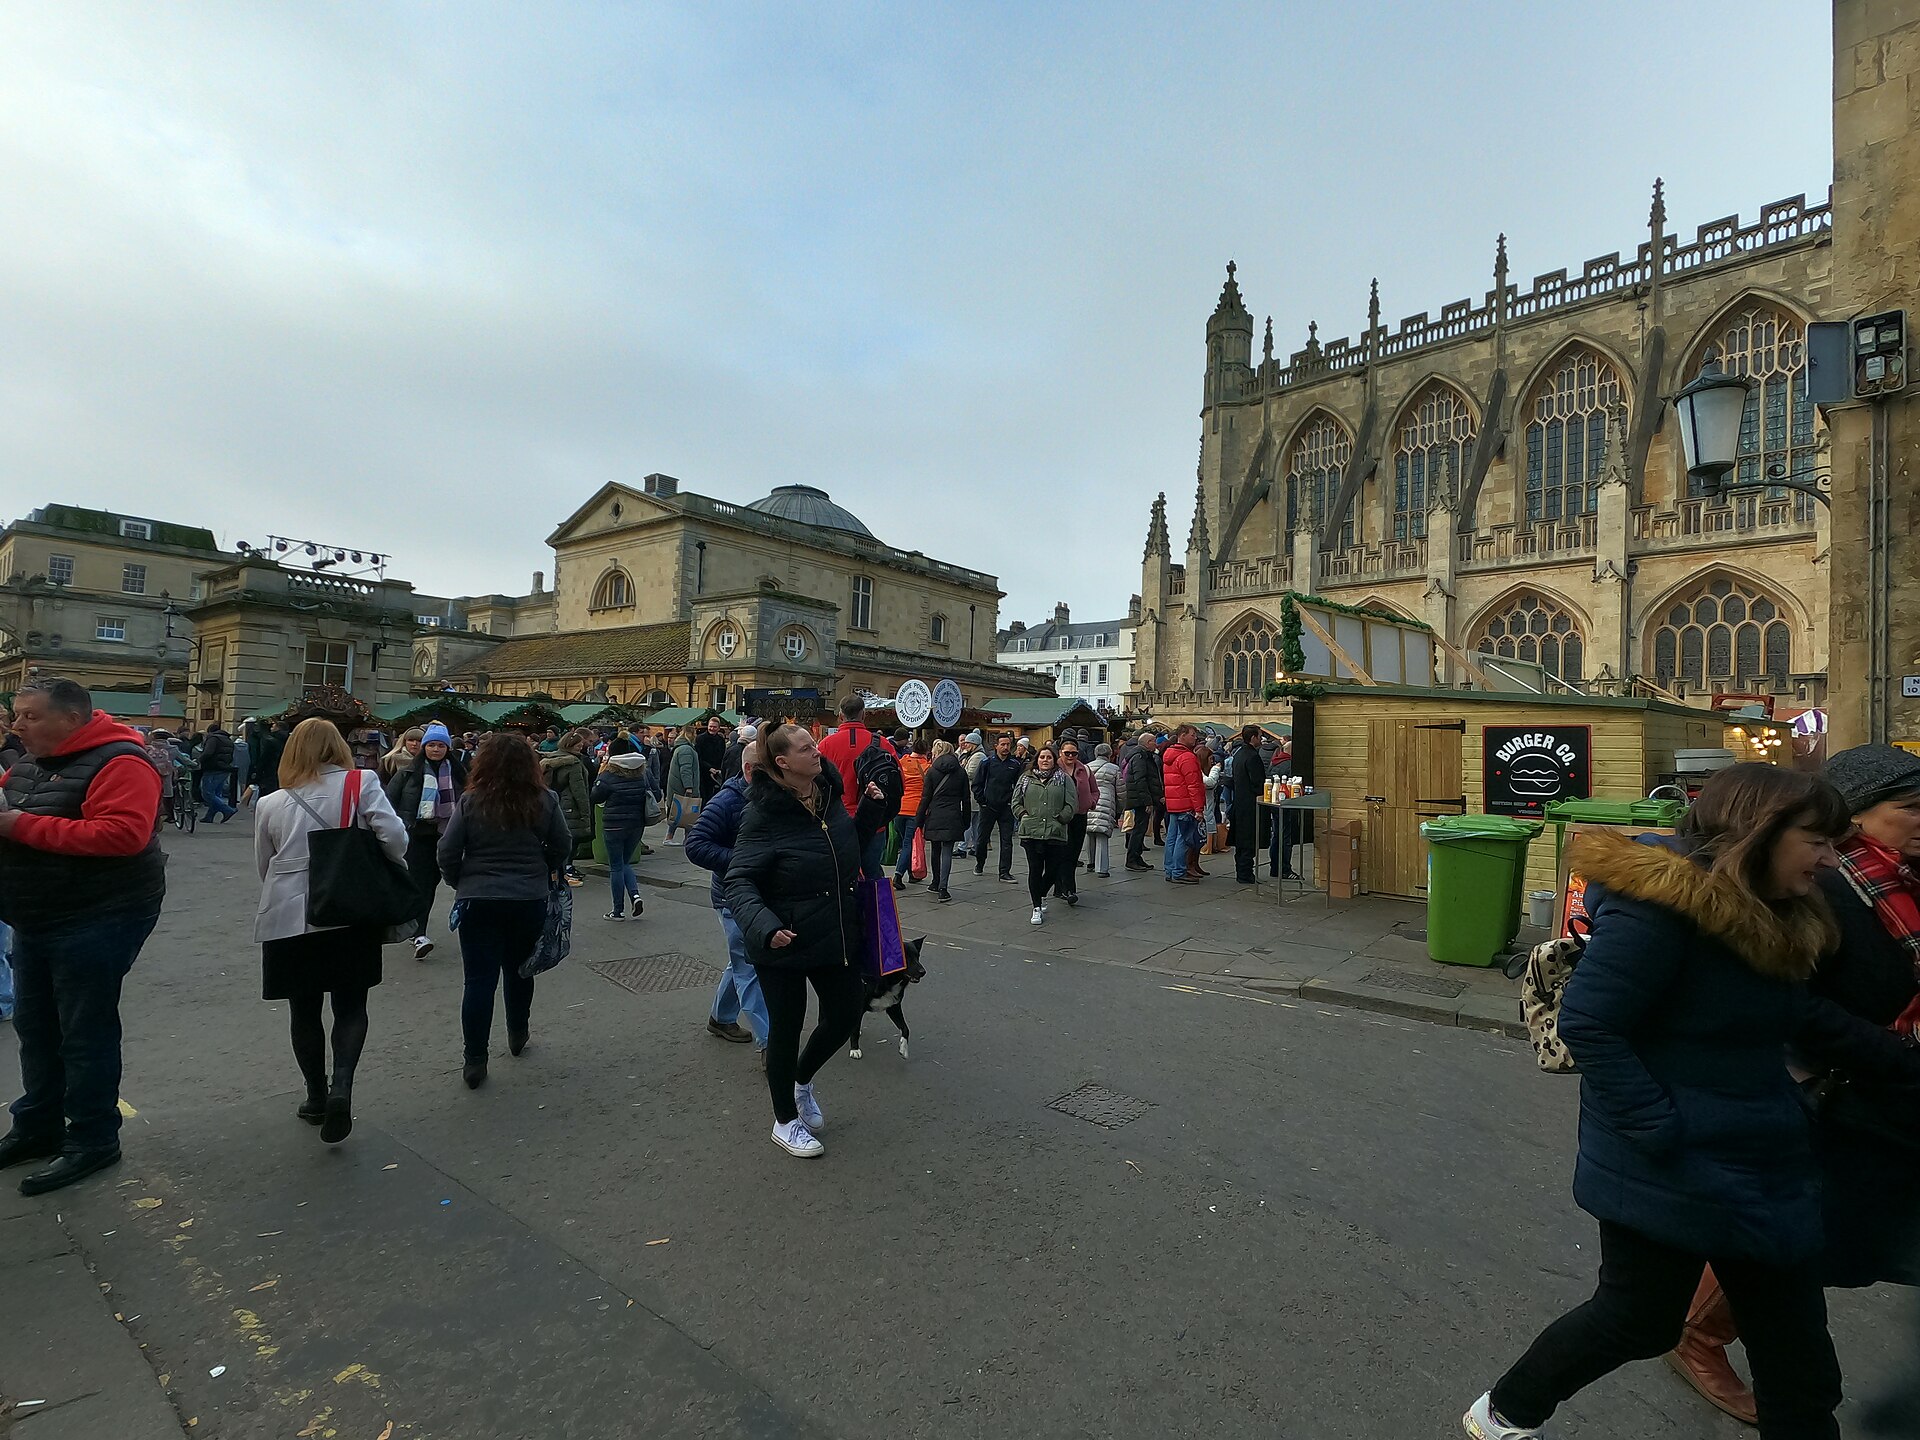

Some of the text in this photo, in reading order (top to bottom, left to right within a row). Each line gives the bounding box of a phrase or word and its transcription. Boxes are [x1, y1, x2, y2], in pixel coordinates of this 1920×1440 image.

[898, 683, 912, 704] GEORGIE
[899, 709, 928, 723] PUDDINGS
[1495, 733, 1576, 766] BURGER CO.
